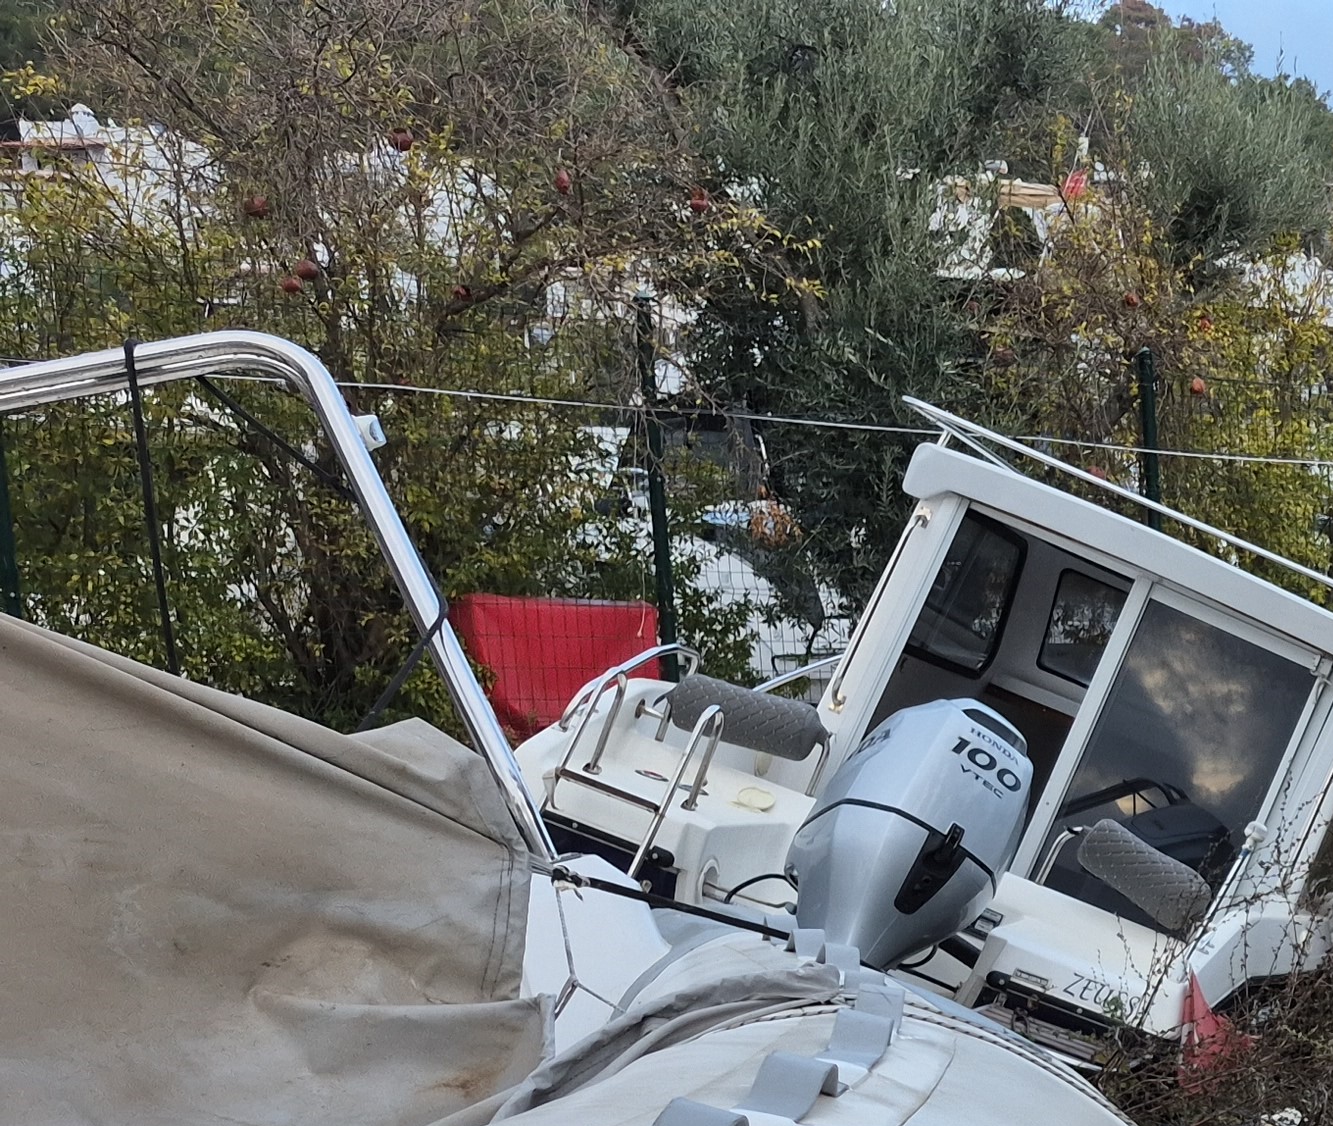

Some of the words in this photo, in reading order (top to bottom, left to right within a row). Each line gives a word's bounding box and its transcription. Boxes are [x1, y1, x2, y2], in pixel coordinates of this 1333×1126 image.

[951, 736, 1022, 793] 100
[970, 726, 1020, 766] HONDA
[960, 764, 1004, 800] VTEC
